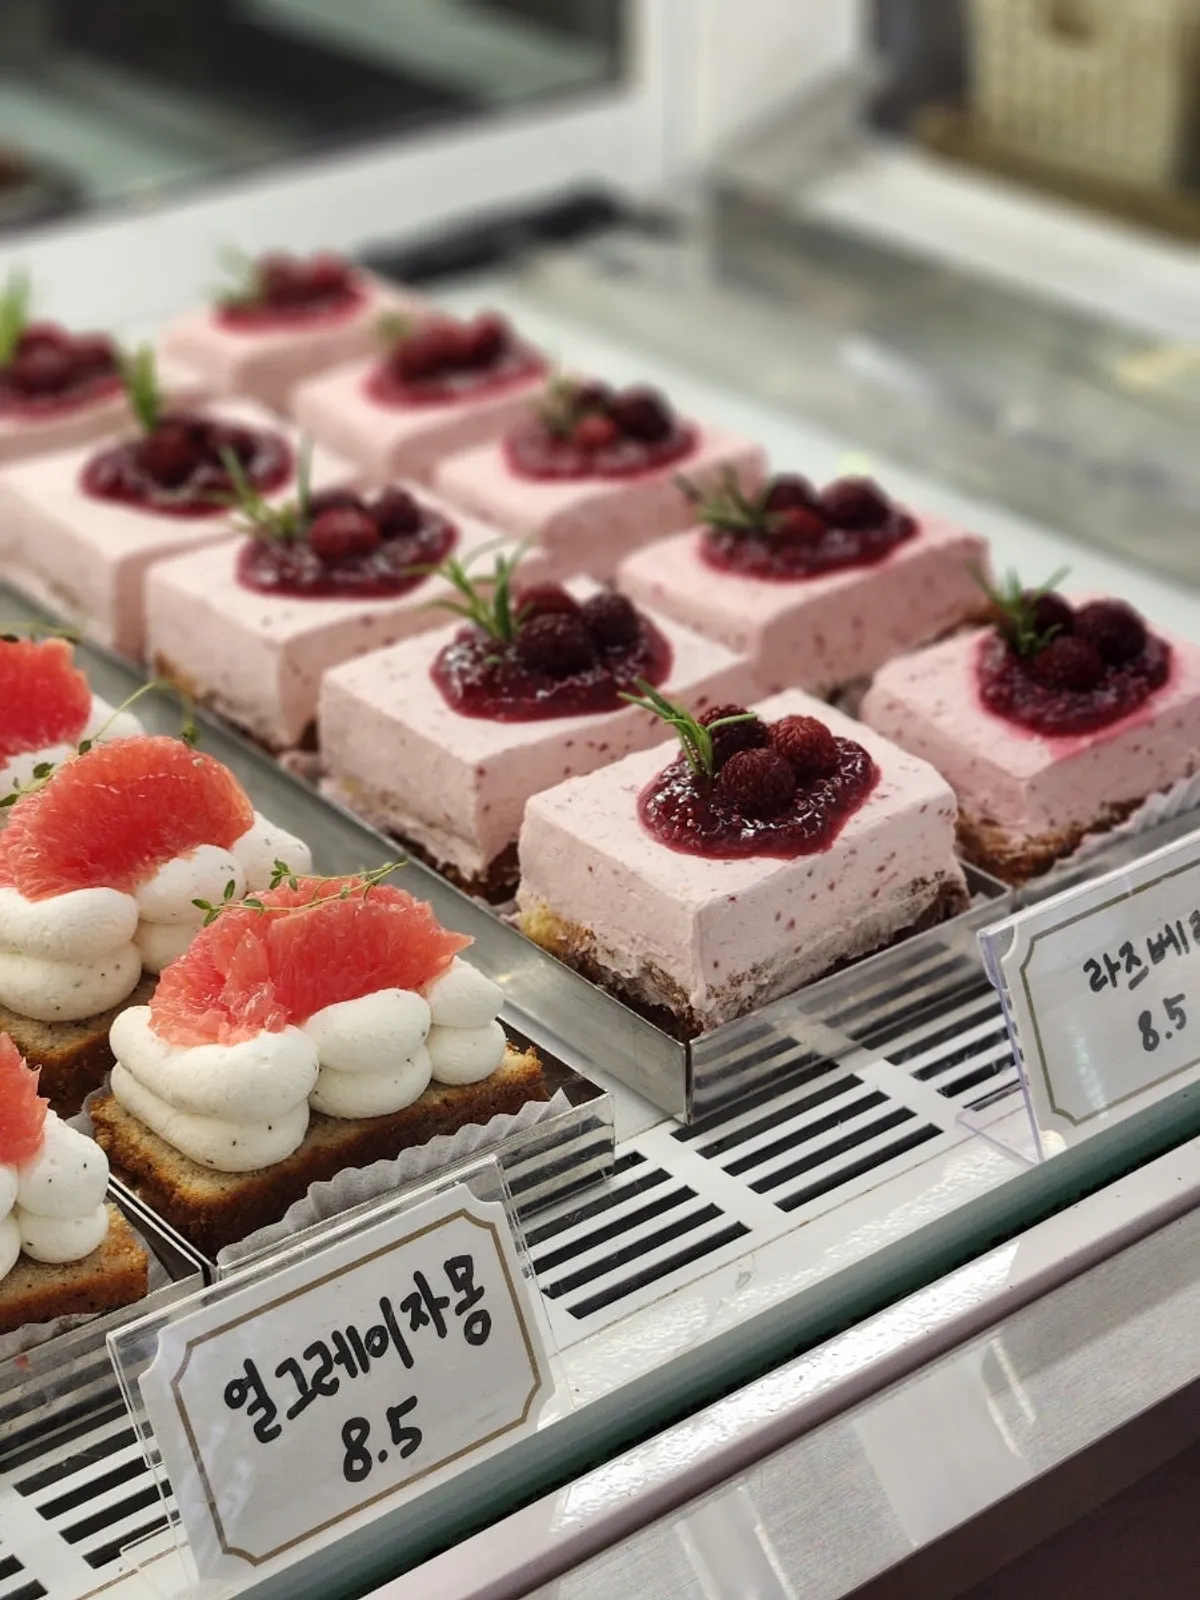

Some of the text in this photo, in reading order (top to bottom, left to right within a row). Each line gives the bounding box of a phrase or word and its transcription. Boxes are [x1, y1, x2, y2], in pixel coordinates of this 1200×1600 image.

[1137, 993, 1187, 1052] 8.5
[223, 1254, 493, 1444] 얼그레이자몽
[341, 1395, 424, 1482] 8.5
